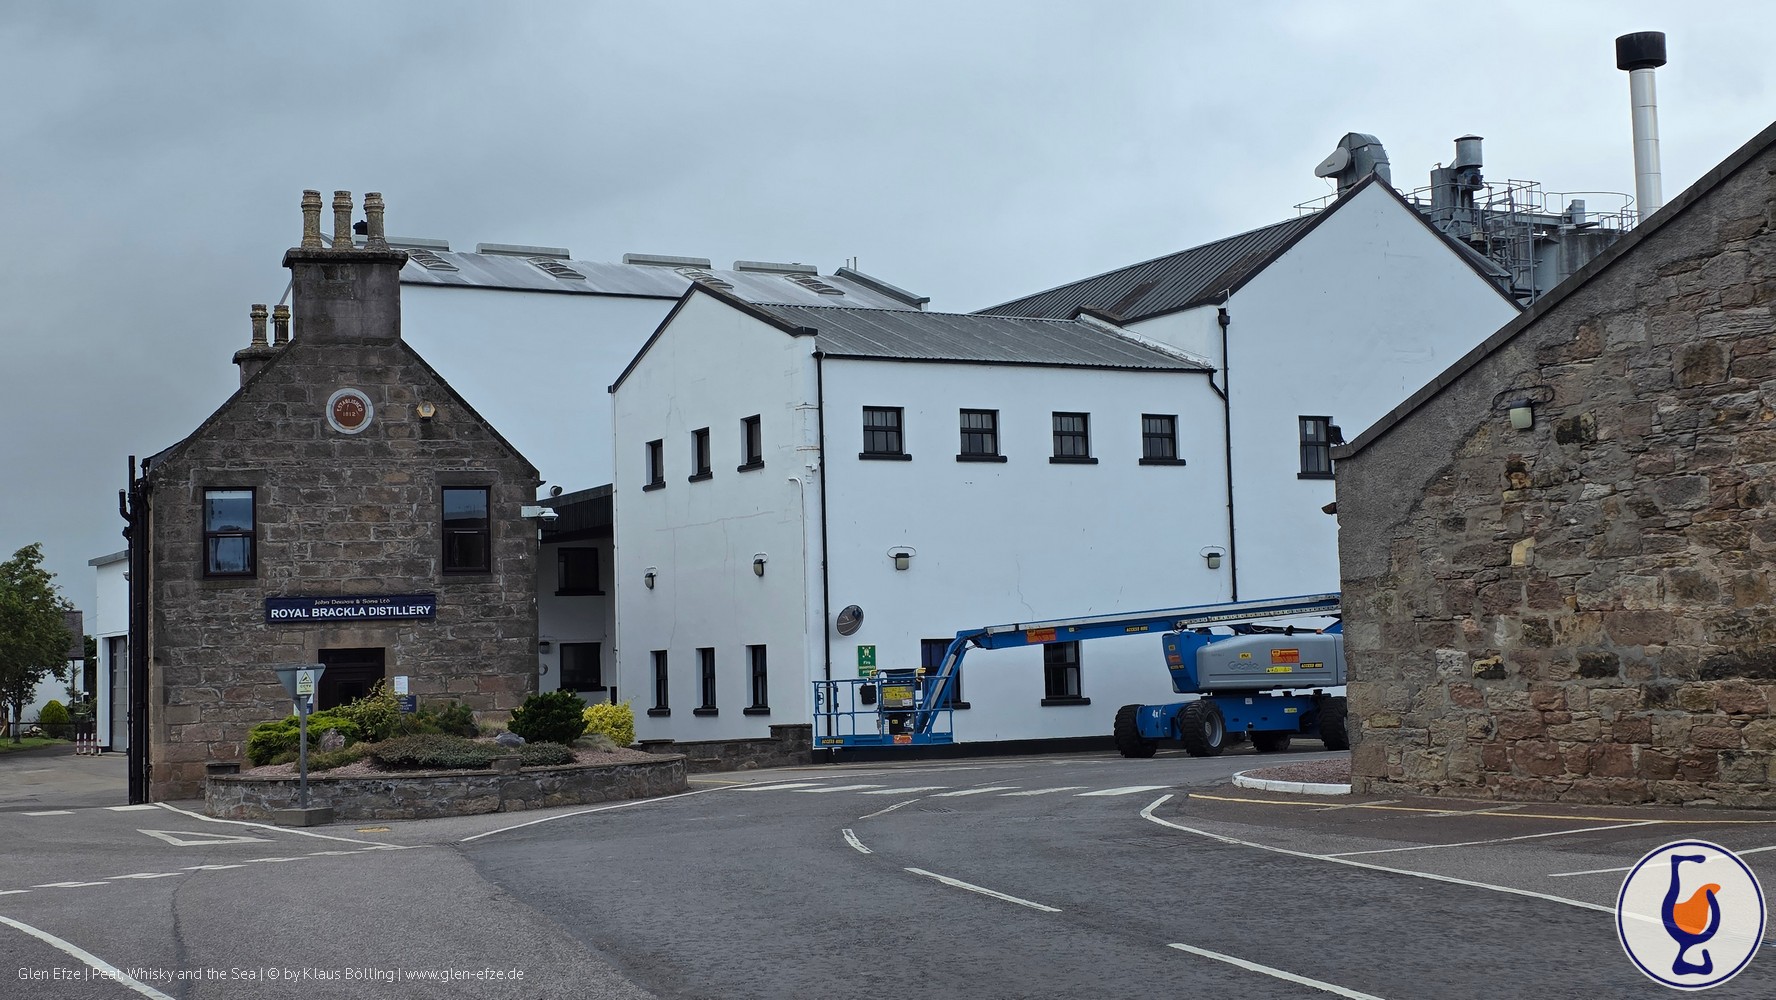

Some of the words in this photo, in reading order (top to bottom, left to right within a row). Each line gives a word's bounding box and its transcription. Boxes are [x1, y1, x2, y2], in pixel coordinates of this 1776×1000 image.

[270, 608, 310, 619] ROYAL
[311, 606, 367, 618] BRACKLA
[368, 605, 432, 616] DISTILLERY
